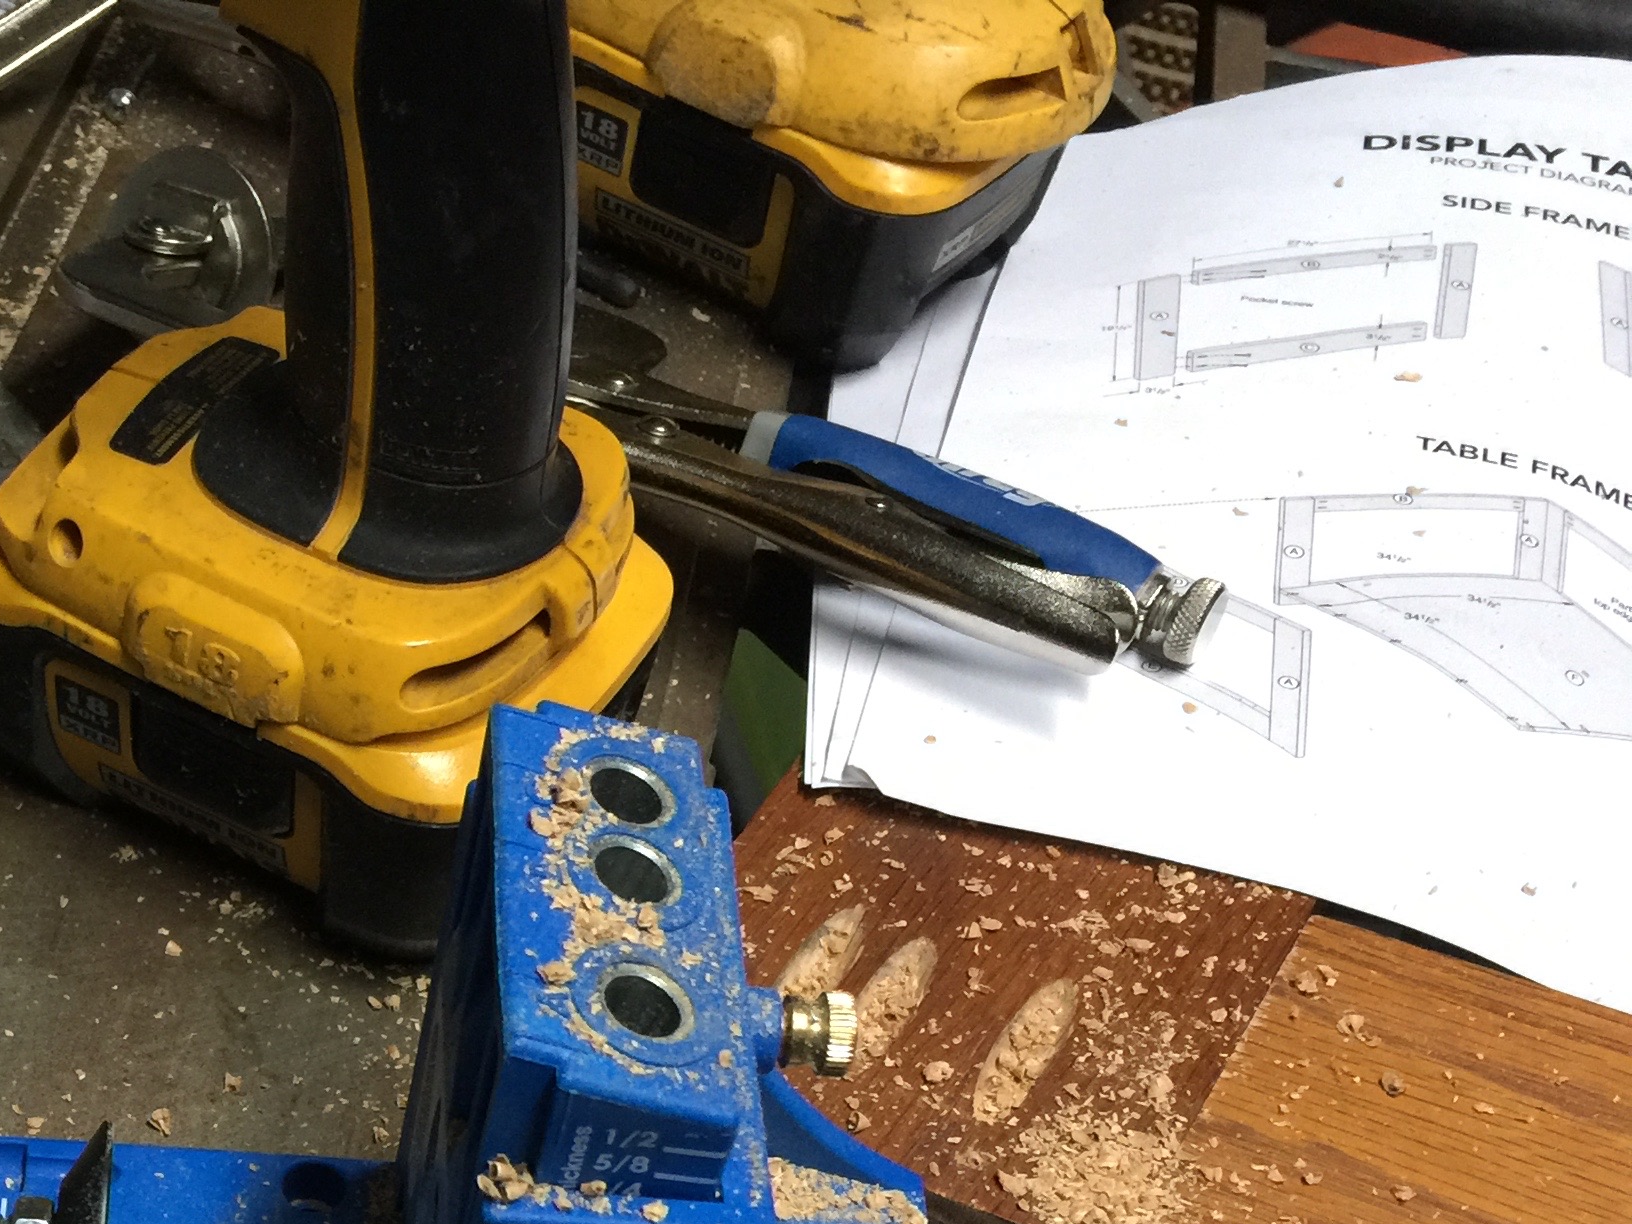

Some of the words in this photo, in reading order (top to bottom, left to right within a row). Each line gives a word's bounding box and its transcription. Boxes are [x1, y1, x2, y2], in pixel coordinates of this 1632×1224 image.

[579, 128, 617, 151] VOLT
[580, 110, 619, 140] 18
[1362, 134, 1567, 164] DISPLAY
[1581, 151, 1632, 180] TA
[1429, 155, 1533, 175] PROJECT
[1442, 194, 1513, 215] SIDE
[1523, 205, 1631, 240] FRAME
[1416, 435, 1519, 469] TABLE
[66, 685, 110, 717] 18
[607, 1128, 658, 1148] 1/2
[558, 1126, 593, 1188] ickness
[593, 1153, 649, 1173] 5/8
